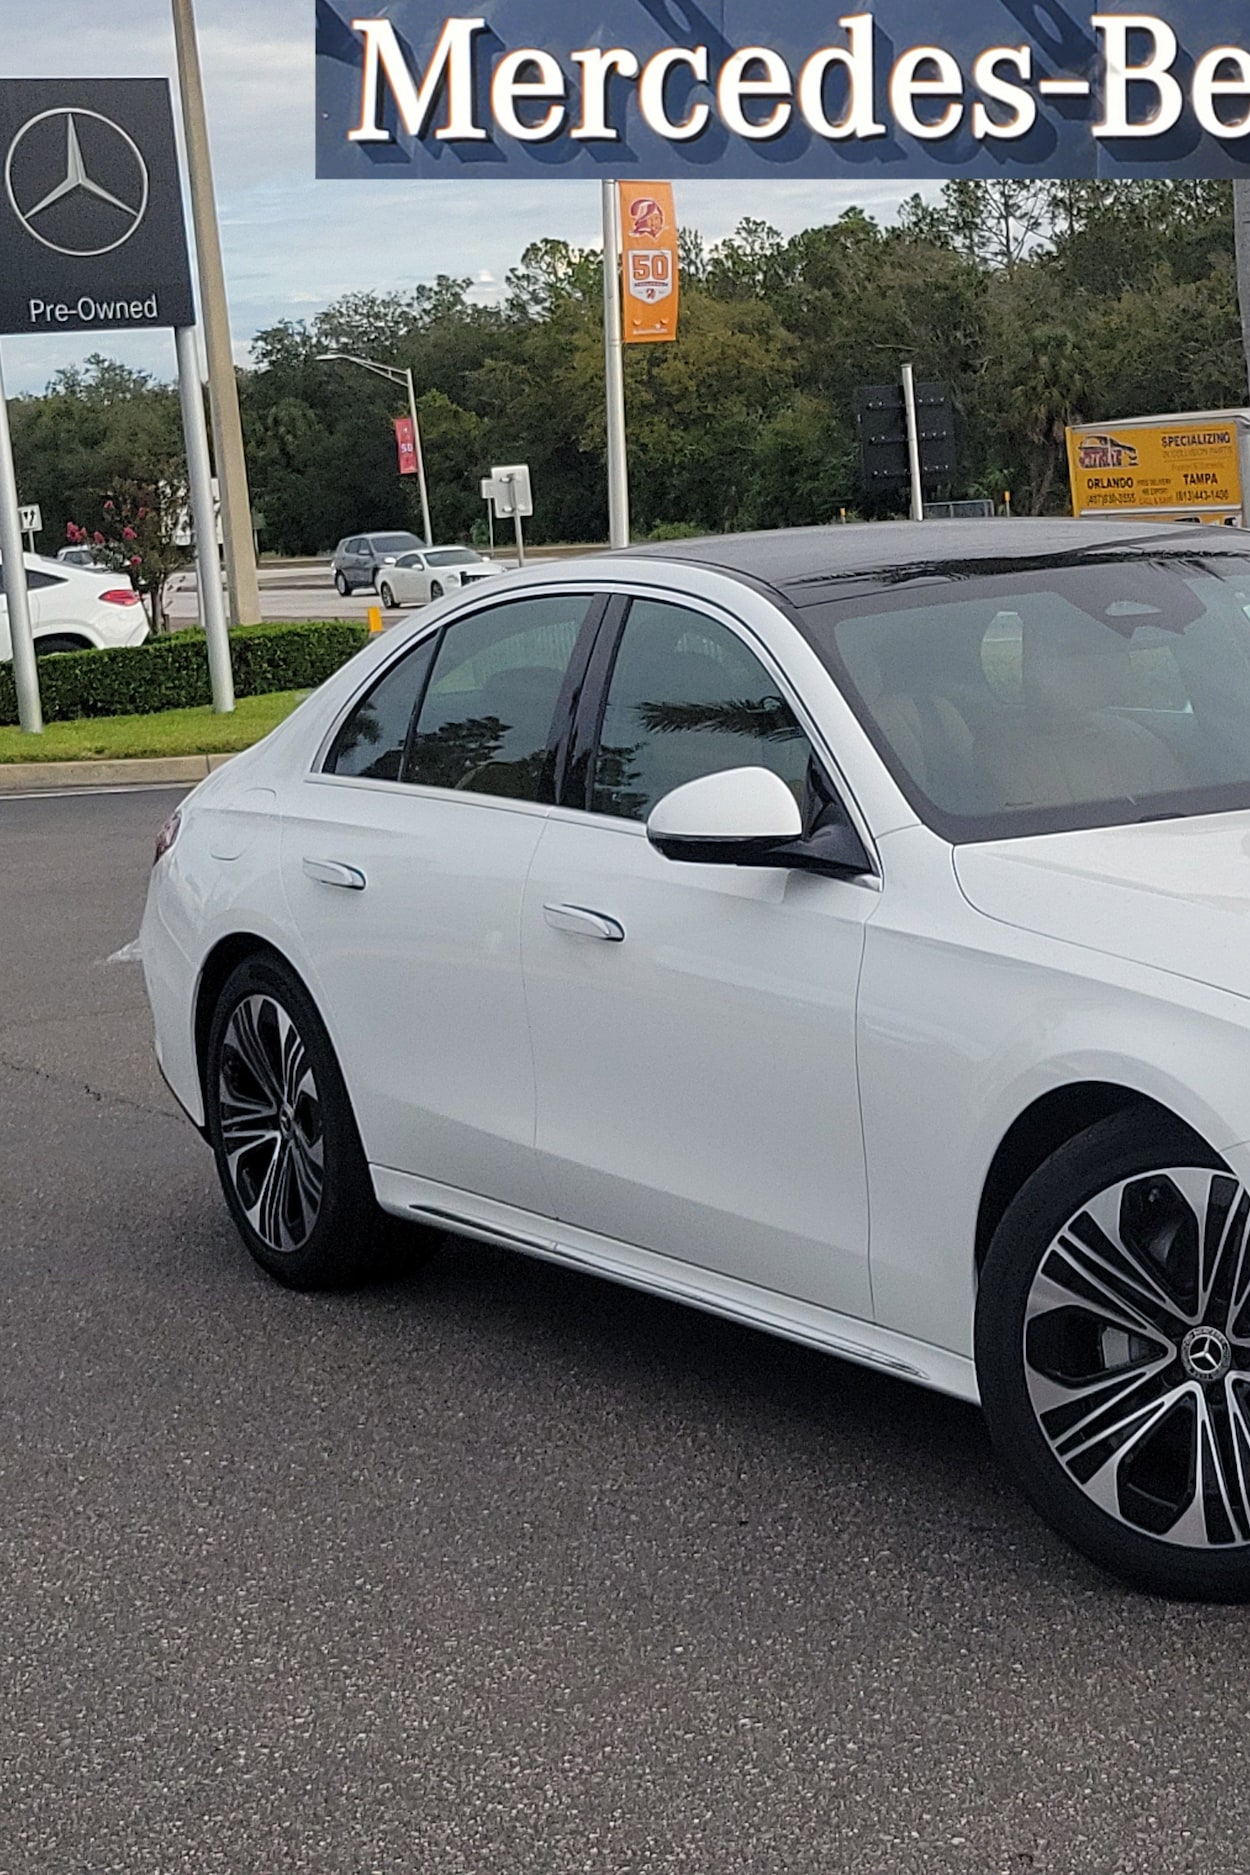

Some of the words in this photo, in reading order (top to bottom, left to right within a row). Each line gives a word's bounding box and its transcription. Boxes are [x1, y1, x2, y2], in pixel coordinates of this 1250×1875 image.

[632, 254, 669, 281] 50
[29, 294, 158, 323] Pre-Owned
[1161, 431, 1231, 448] SPECIALIZING
[1087, 476, 1134, 490] ORLANDO
[1183, 472, 1218, 486] TAMPA
